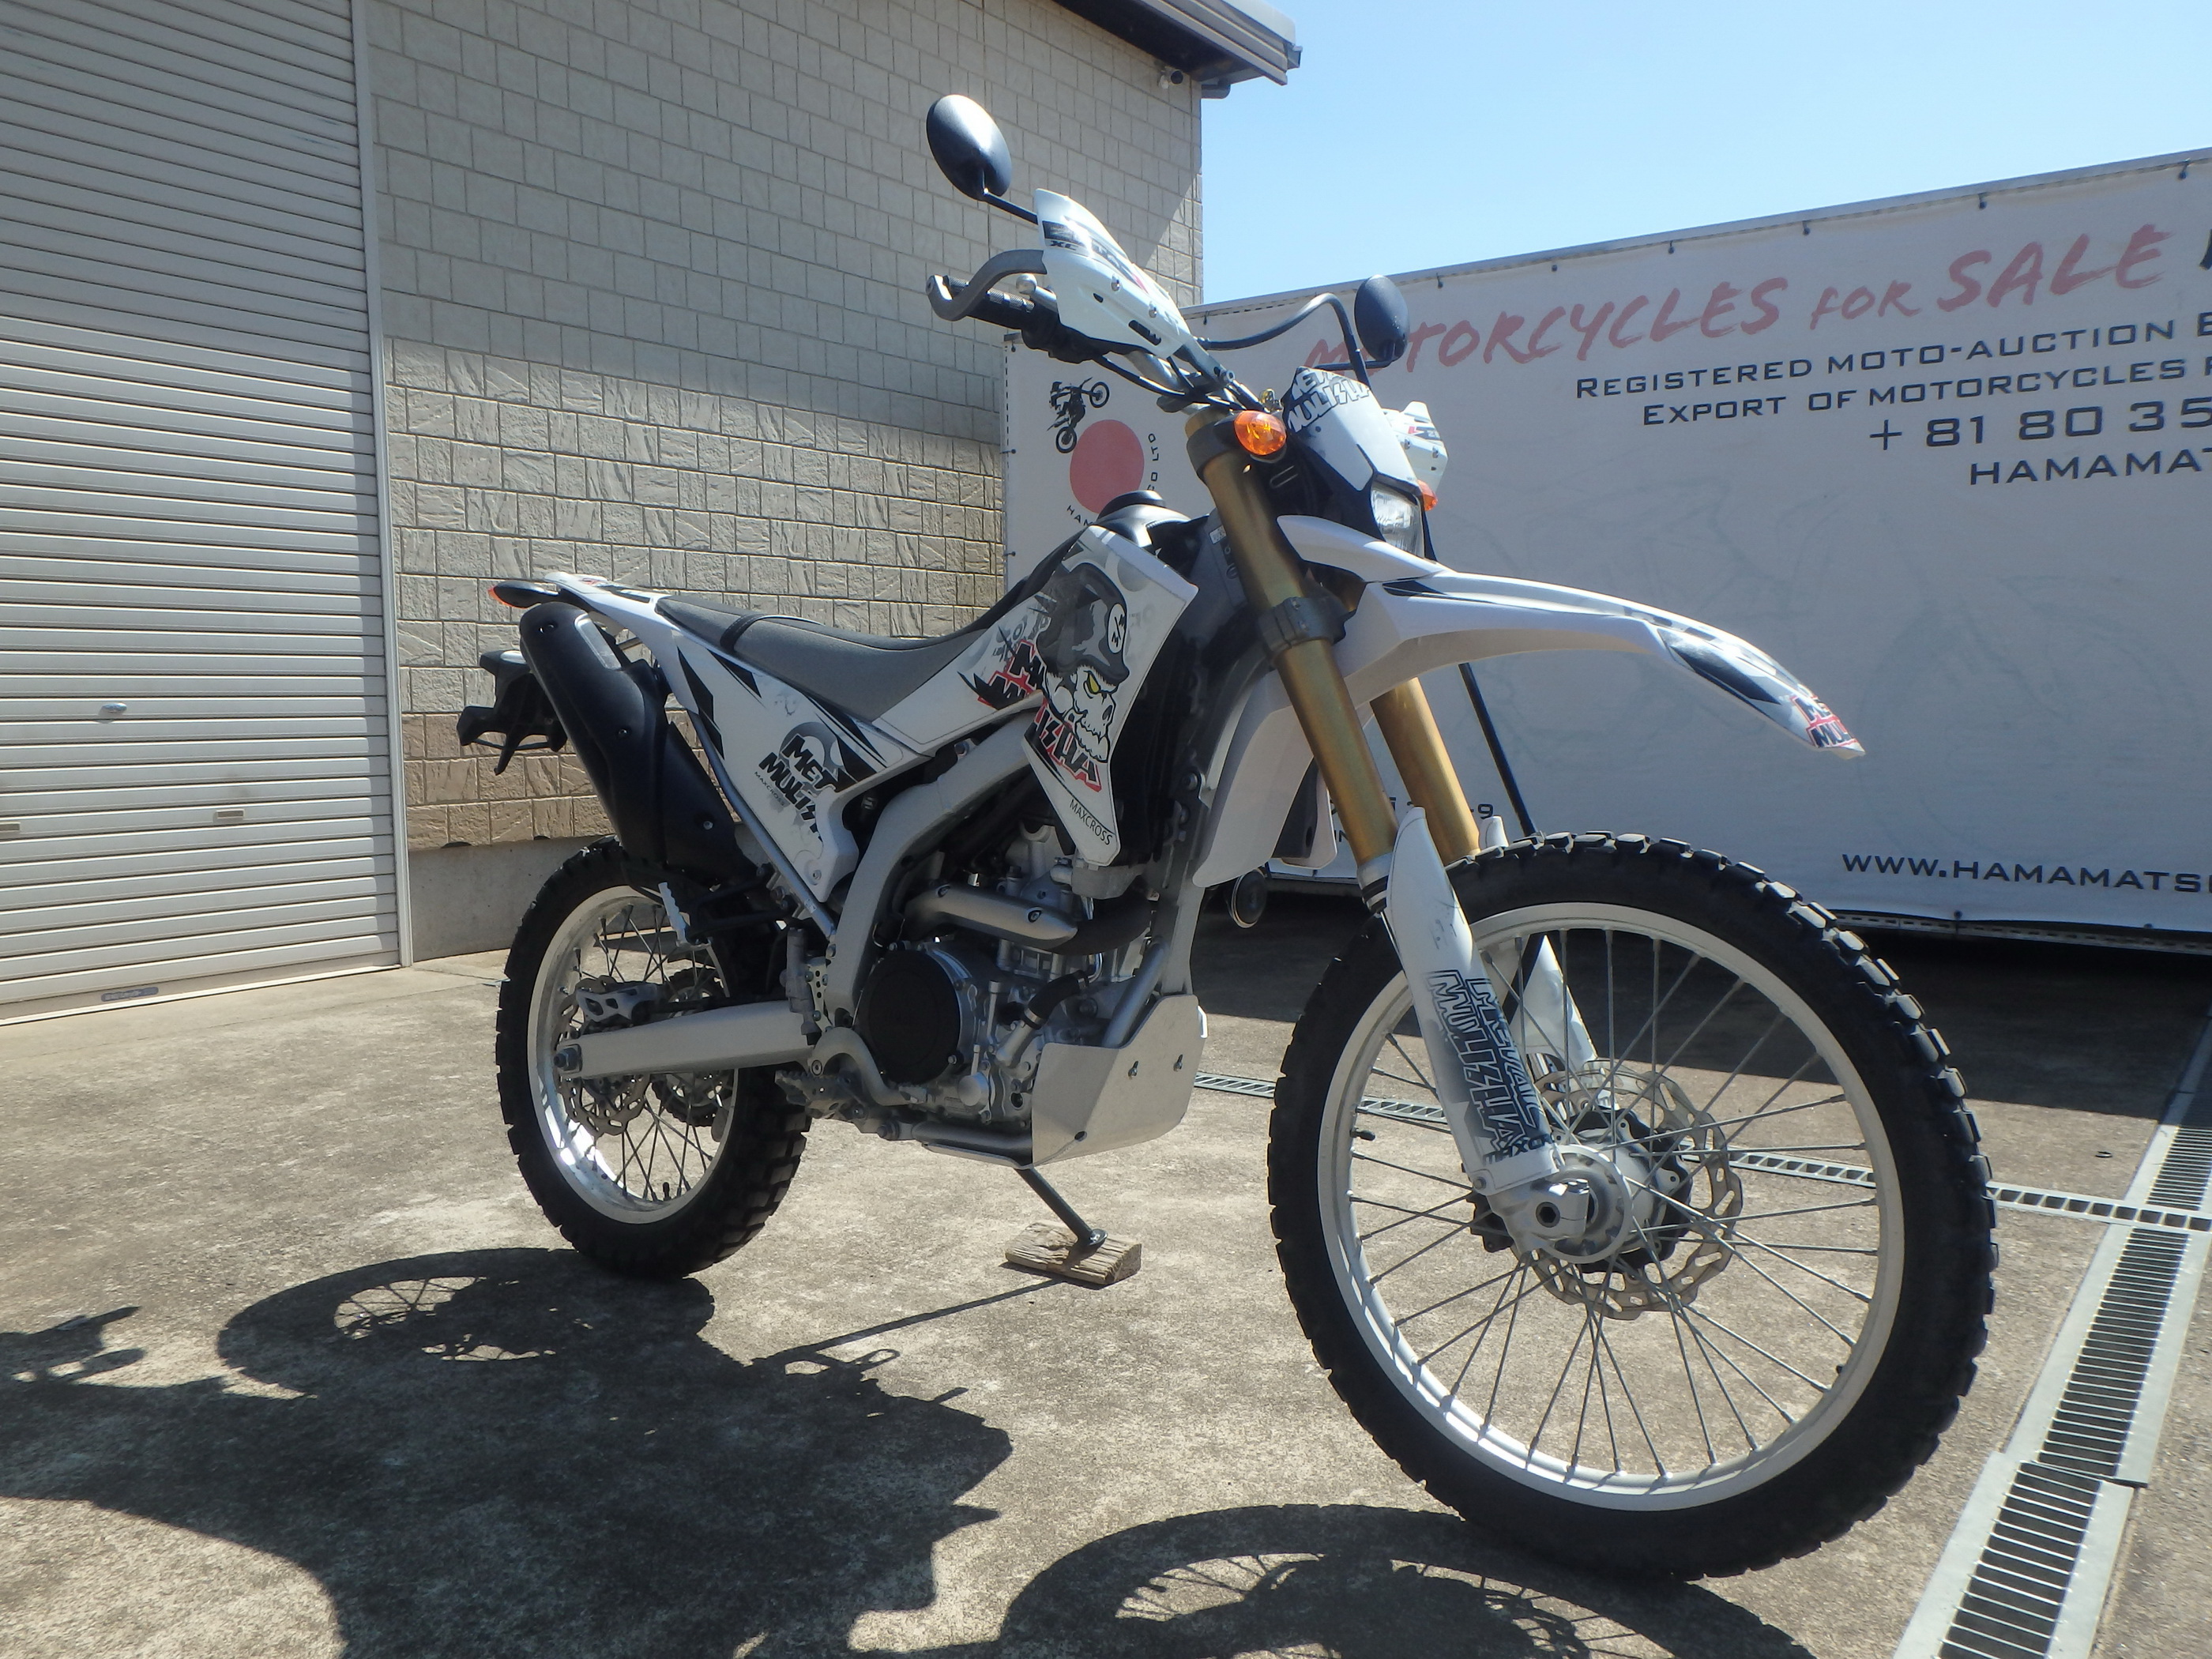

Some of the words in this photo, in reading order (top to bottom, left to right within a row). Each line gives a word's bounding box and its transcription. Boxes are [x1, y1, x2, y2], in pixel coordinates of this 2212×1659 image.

[1302, 277, 1788, 378] MTORCYCLES
[1936, 224, 2172, 313] SALE
[1576, 360, 1812, 399] REGISTERED
[1828, 319, 2174, 374] MOTO-AUCTION
[1643, 396, 1786, 425] EXPORT
[1808, 389, 1857, 412] OF
[1868, 359, 2187, 406] MOTORCYCLES
[1148, 433, 1160, 461] LTD
[1926, 416, 1984, 447] 81
[2018, 405, 2103, 440] 80
[2128, 397, 2212, 433] 35
[1069, 799, 1113, 845] MAXCROSS
[1841, 854, 2212, 893] WWW.HAMAMATS
